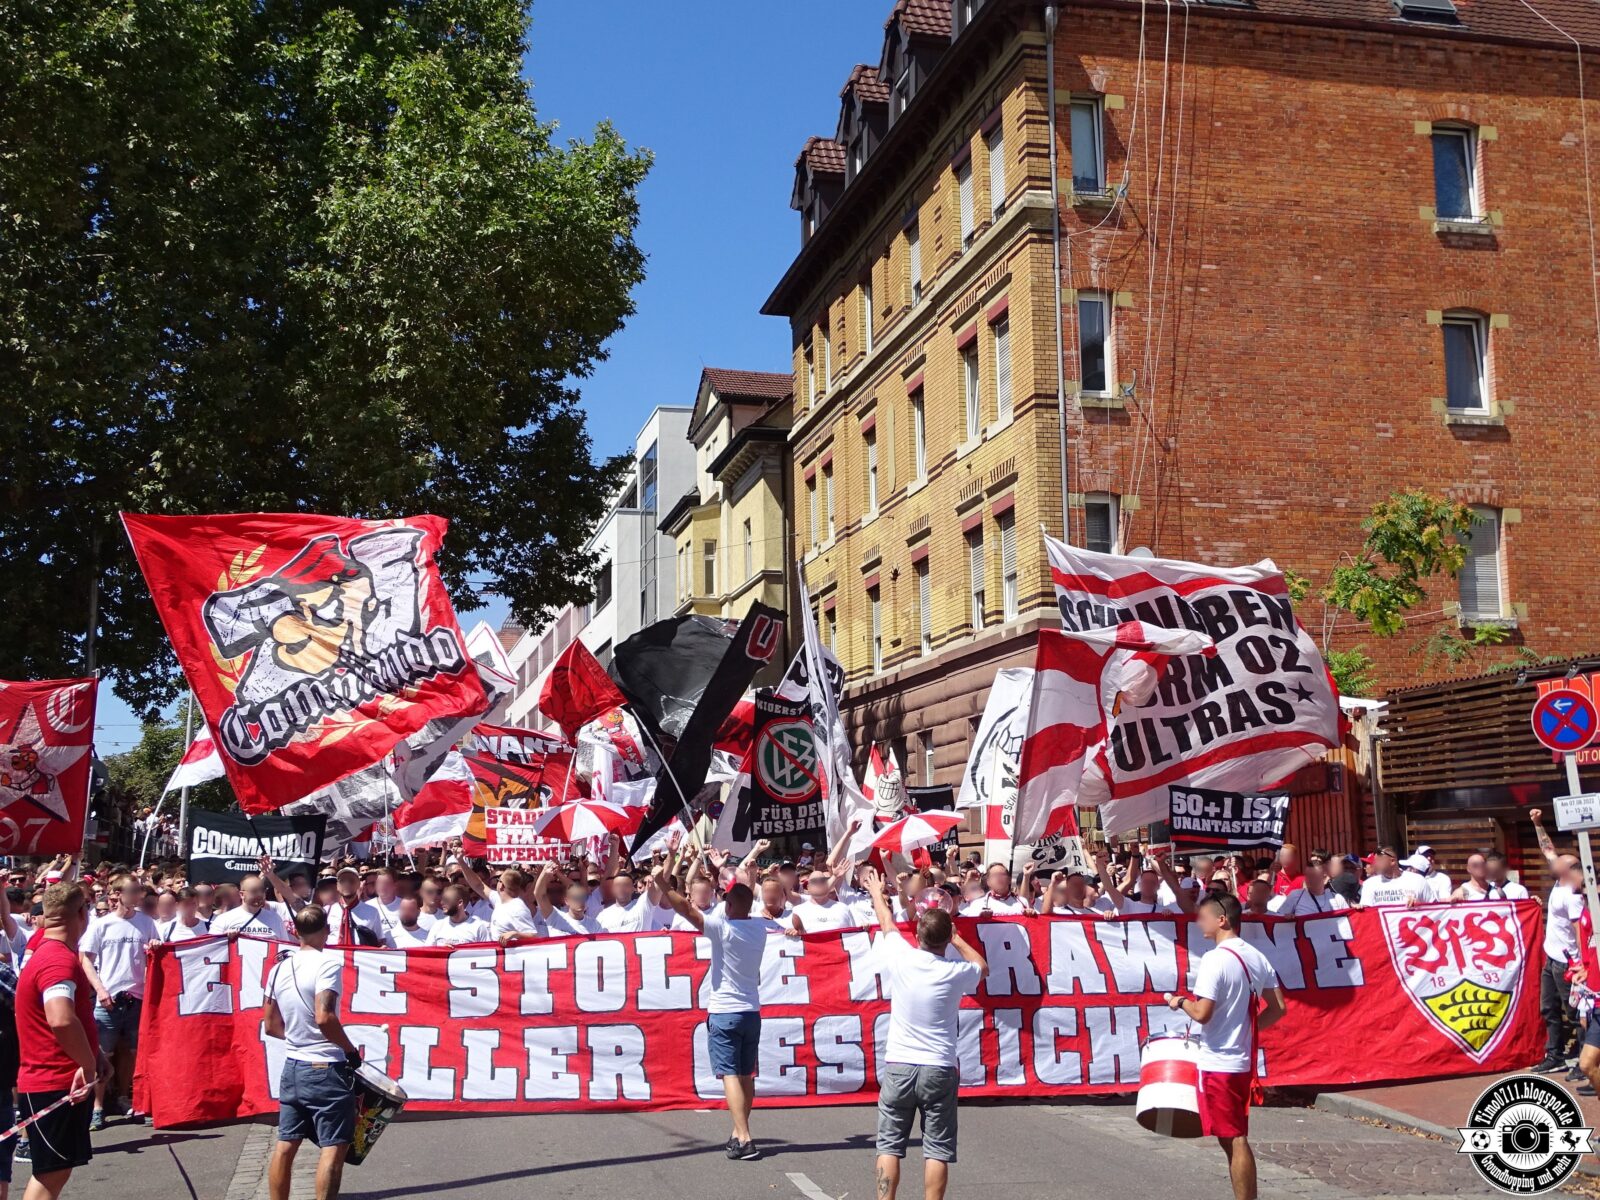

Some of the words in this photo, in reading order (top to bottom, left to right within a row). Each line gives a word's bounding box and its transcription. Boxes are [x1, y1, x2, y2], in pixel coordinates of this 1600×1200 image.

[746, 613, 783, 663] U
[1111, 681, 1296, 772] ULTRAS
[486, 808, 546, 825] STAD
[761, 805, 792, 821] FÜR
[1242, 797, 1289, 819] IST
[752, 817, 825, 836] FUSSBAL
[192, 826, 317, 858] COMMANDO
[487, 847, 572, 863] INTERNET
[225, 859, 264, 872] Canns
[175, 935, 408, 1017] EIE
[840, 915, 1365, 1001] KRAWNE
[1430, 976, 1447, 988] 18
[1483, 972, 1501, 985] 93
